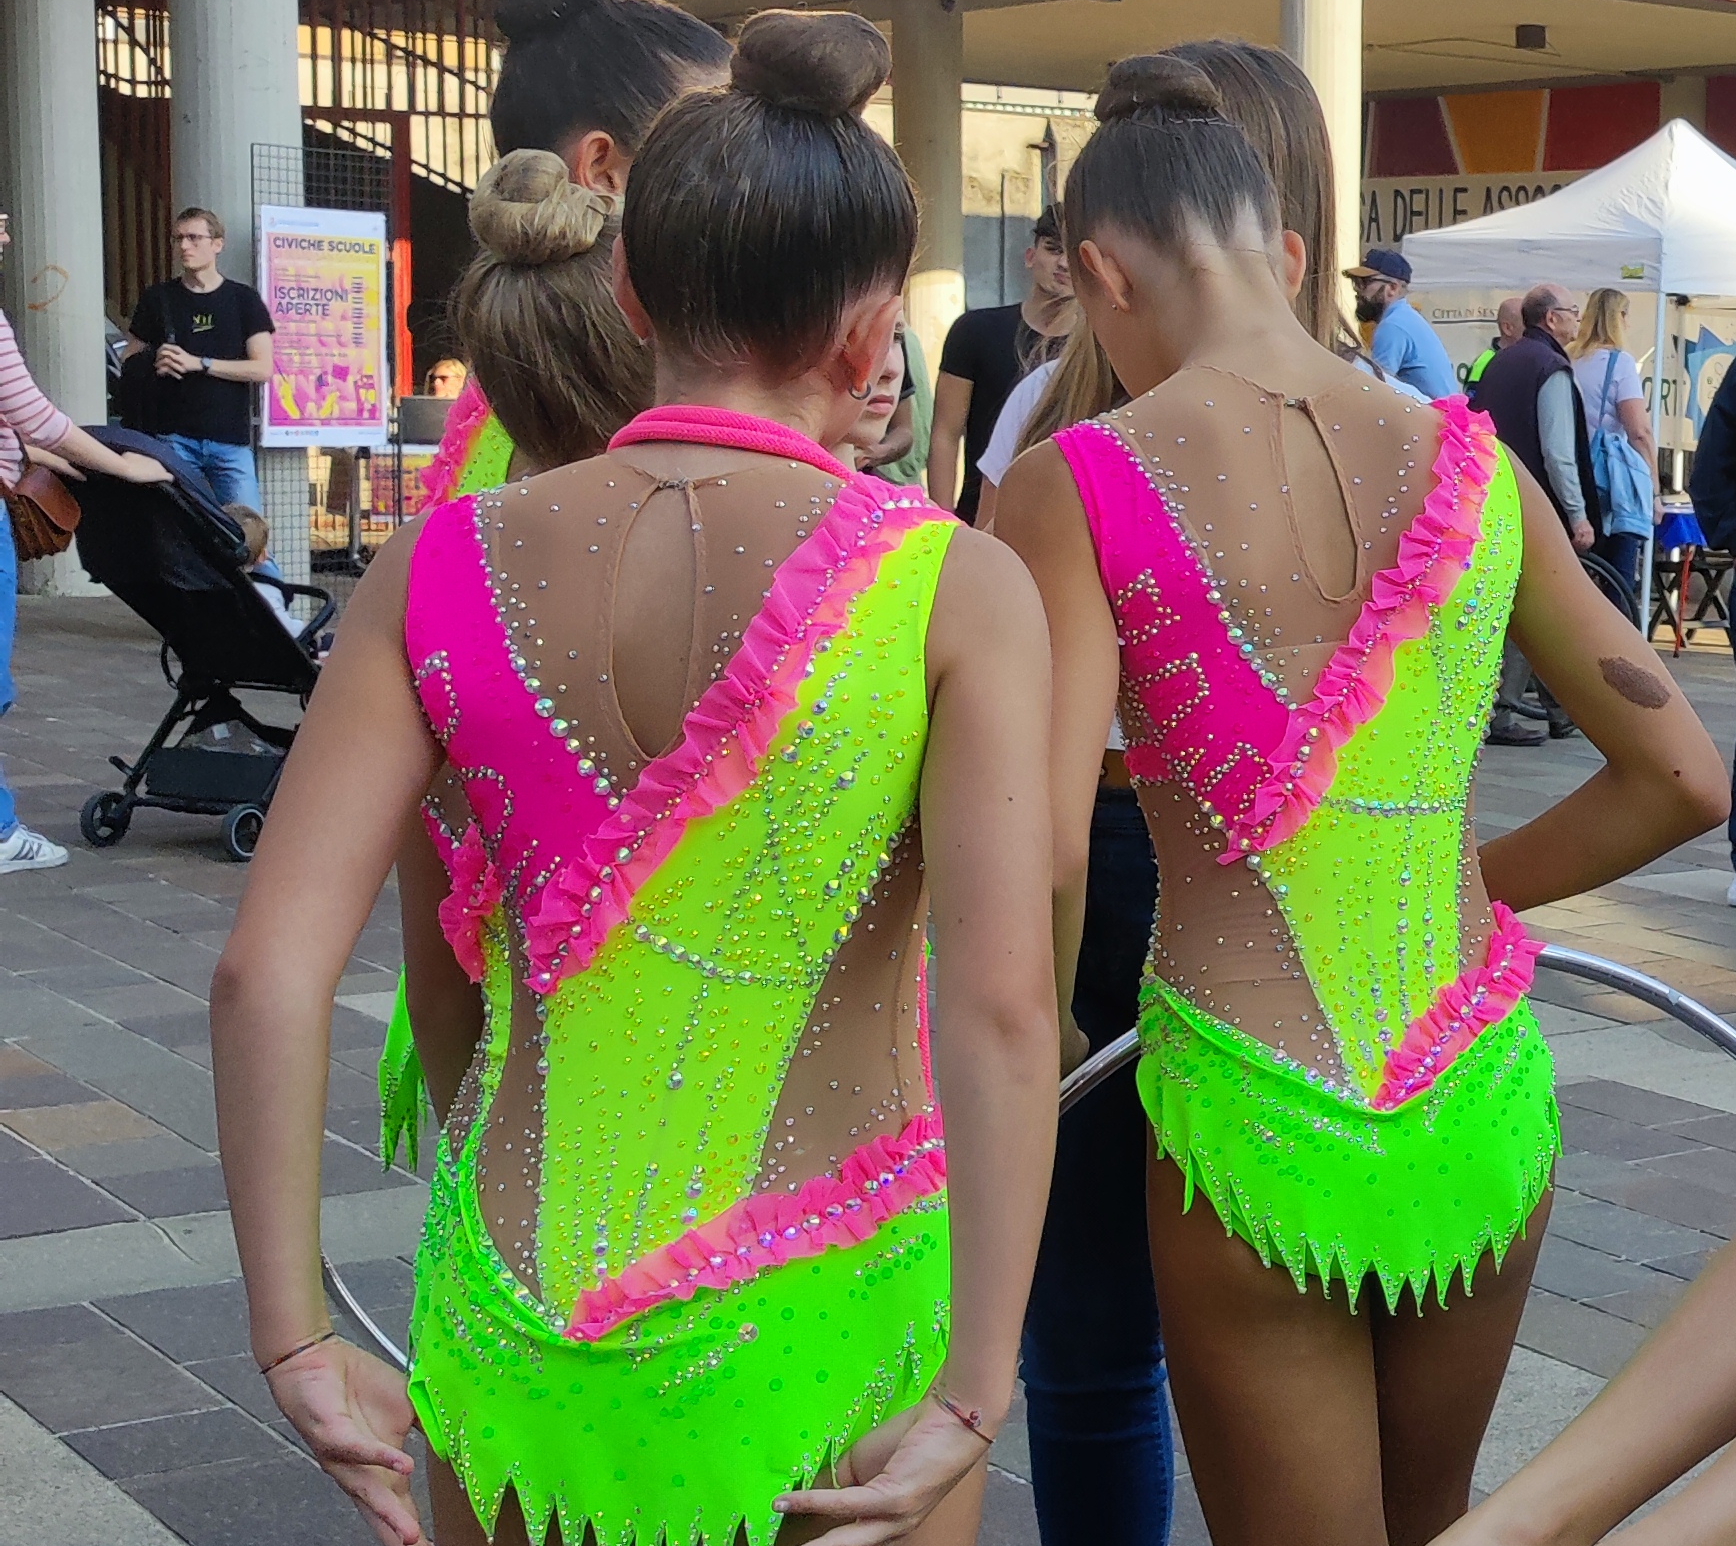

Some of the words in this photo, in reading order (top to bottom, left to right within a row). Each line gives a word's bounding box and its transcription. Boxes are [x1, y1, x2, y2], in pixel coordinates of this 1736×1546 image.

[273, 236, 325, 252] CIVICHE
[327, 240, 377, 255] SCUOLE
[274, 285, 349, 303] ISCRIZIONI
[275, 301, 331, 317] APERTE
